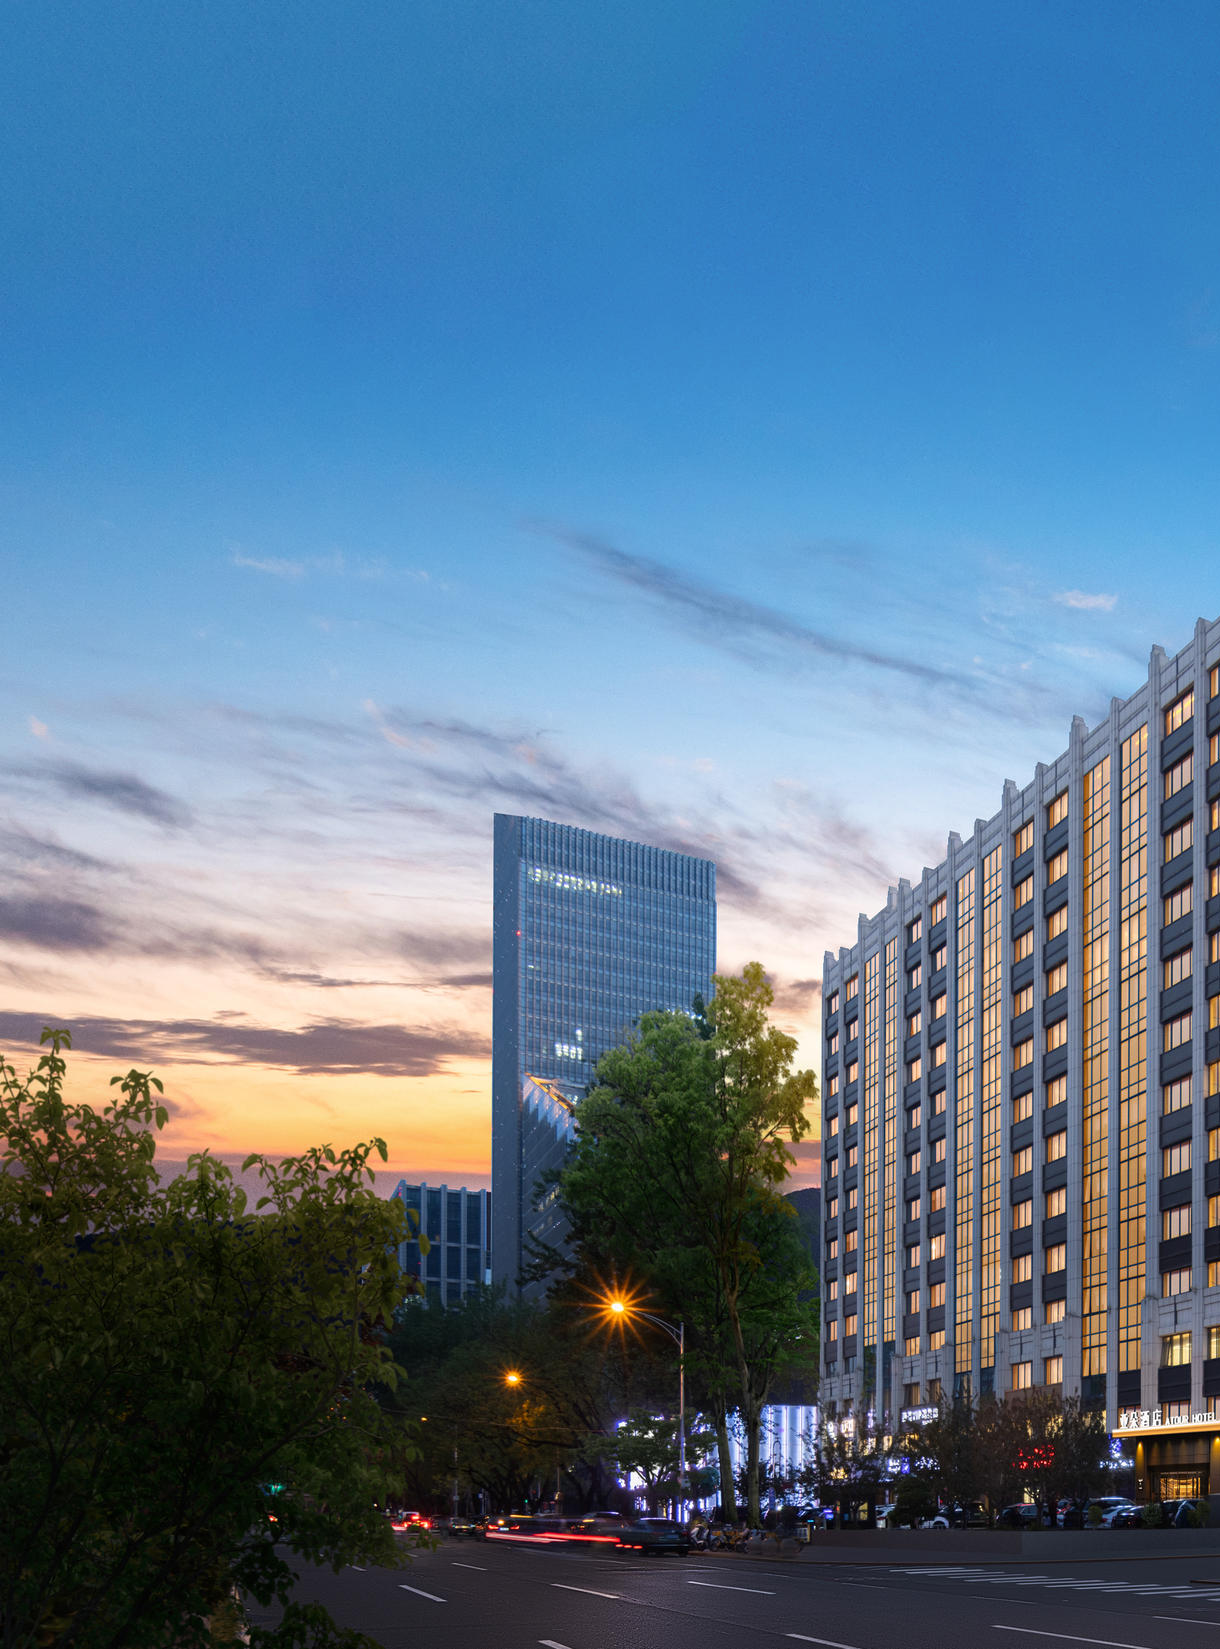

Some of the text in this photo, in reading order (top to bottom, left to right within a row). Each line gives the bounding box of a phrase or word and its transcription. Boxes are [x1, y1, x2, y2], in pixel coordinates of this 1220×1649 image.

[1119, 1408, 1162, 1430] 亚朵酒店
[1165, 1411, 1217, 1426] ATOUR HOTEL
